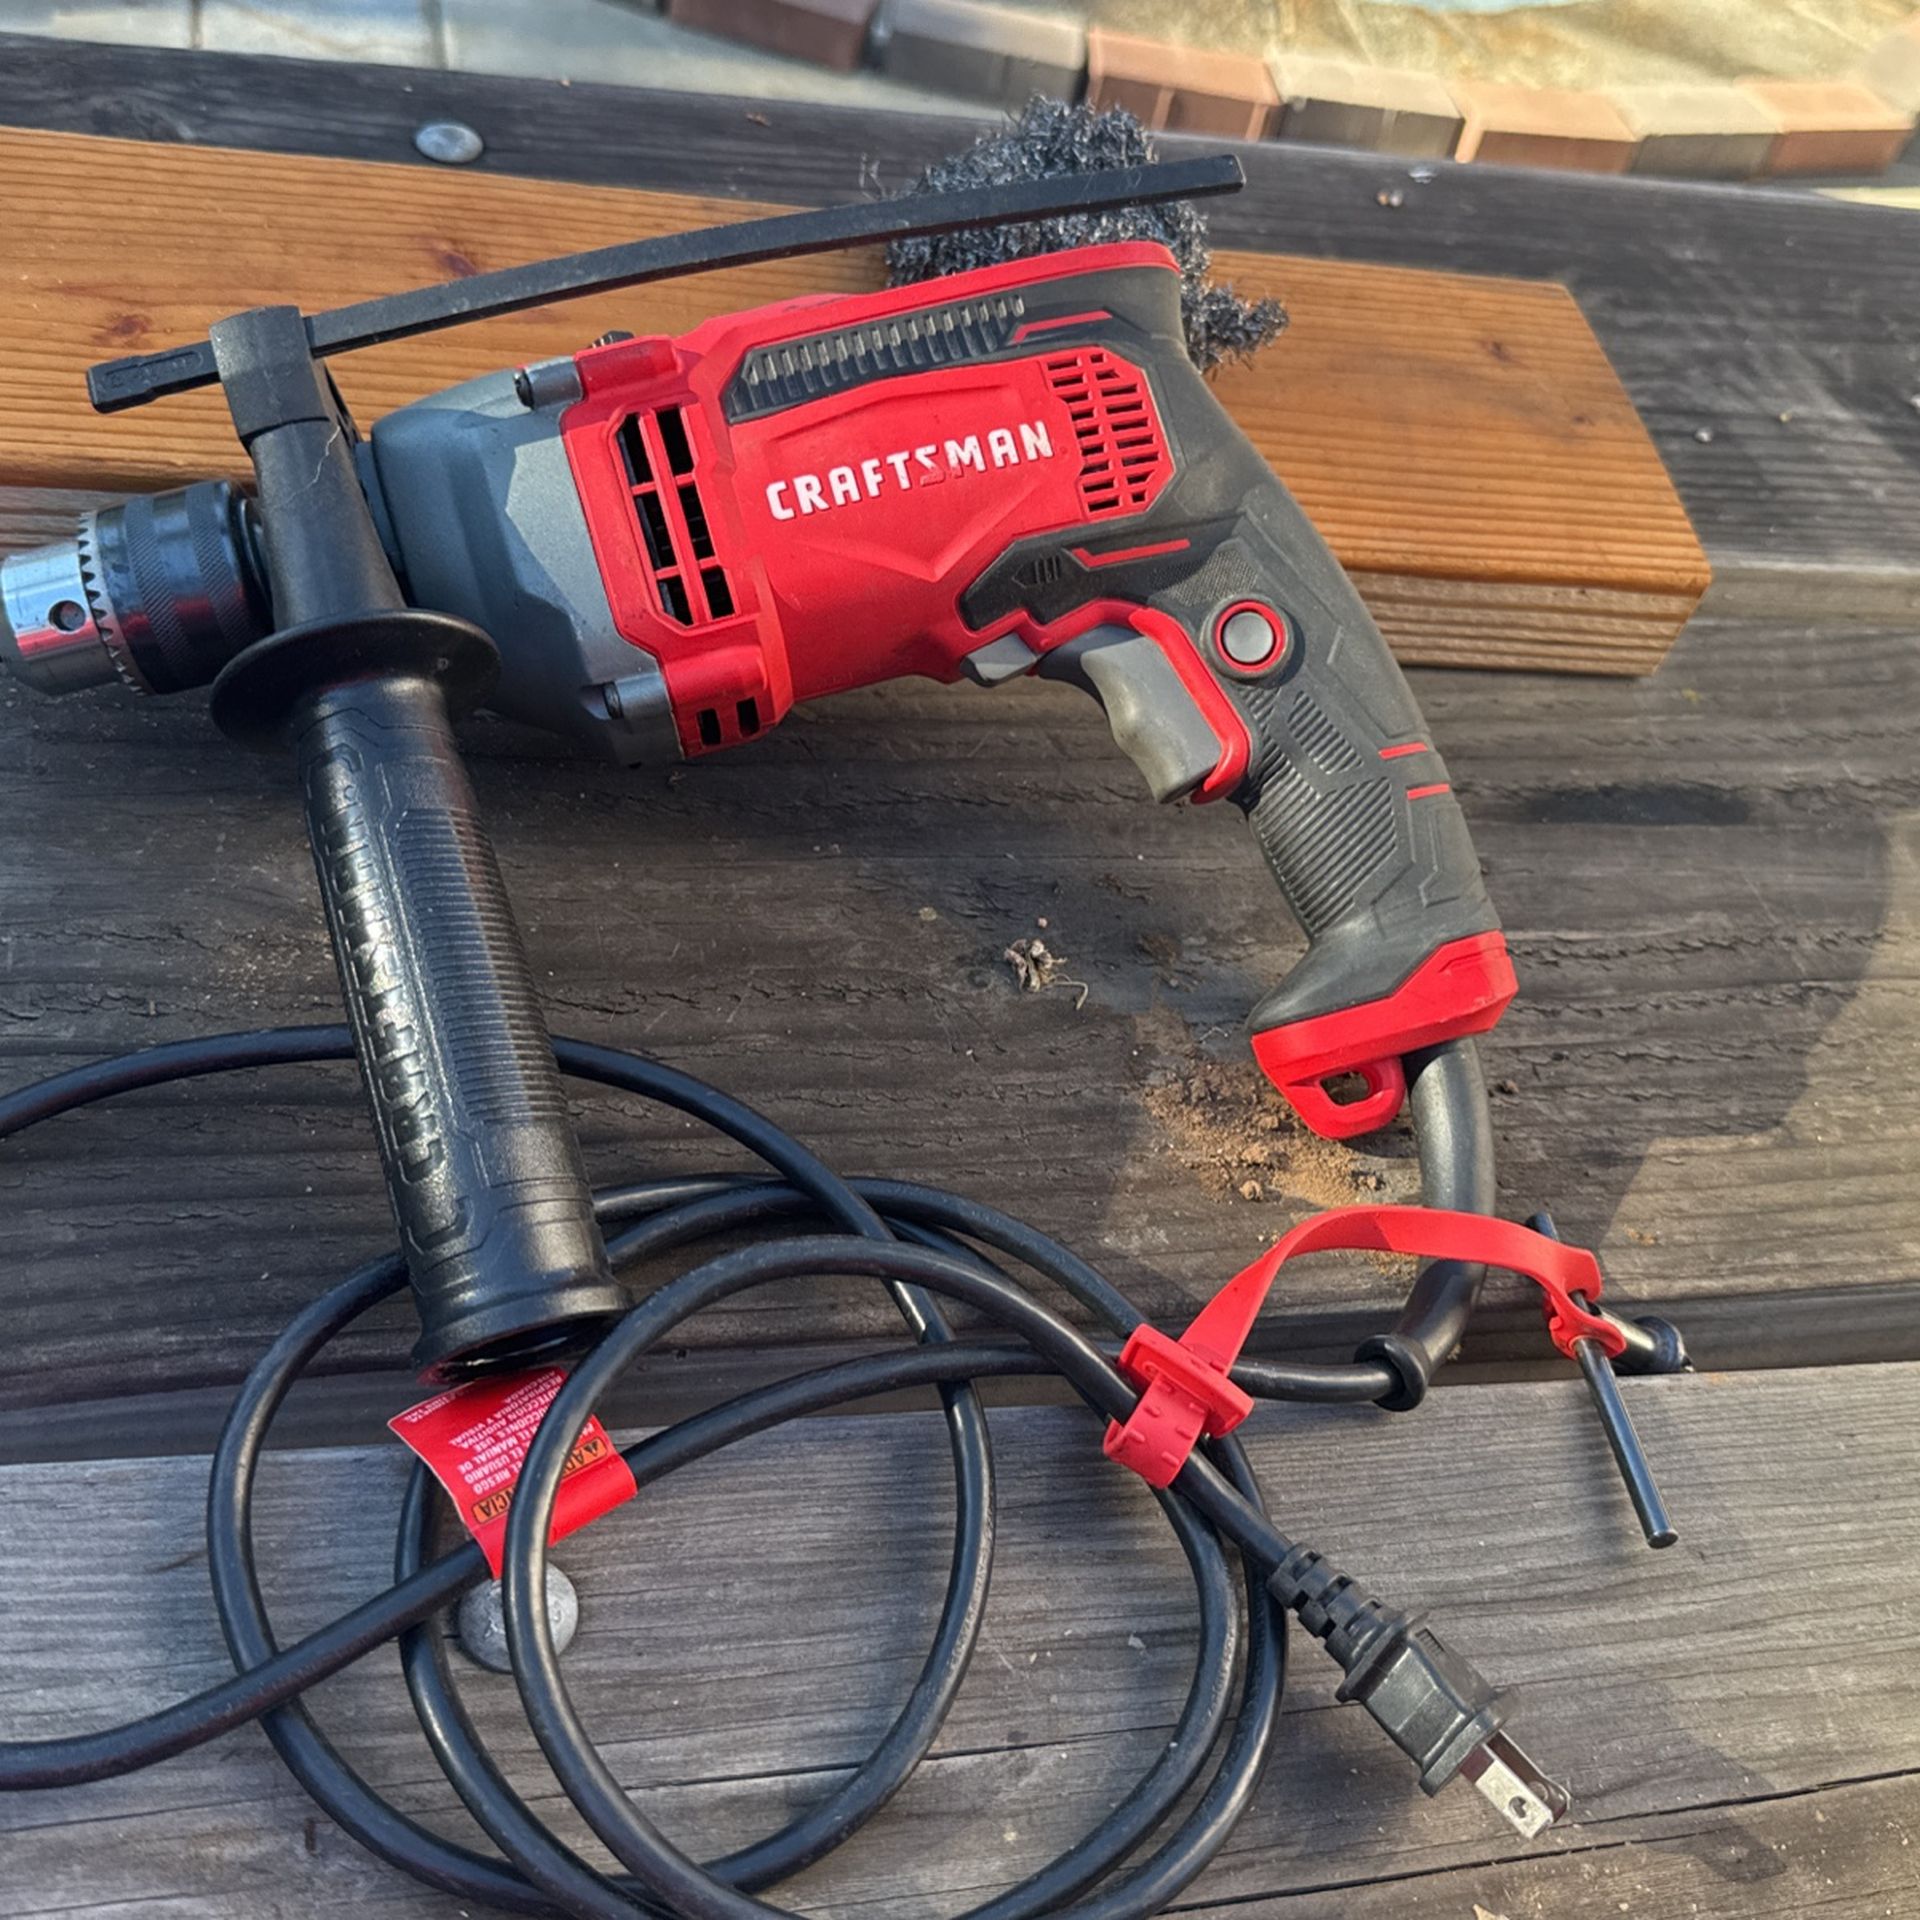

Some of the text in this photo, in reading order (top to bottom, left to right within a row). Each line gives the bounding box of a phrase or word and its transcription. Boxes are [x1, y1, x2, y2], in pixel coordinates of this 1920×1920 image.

[765, 420, 1054, 520] CRAFTSMAN
[448, 1375, 563, 1445] RESPIRATORIA Y VISUAL
[473, 1436, 495, 1453] USE
[473, 1435, 519, 1464] MANUAL
[457, 1460, 473, 1474] DE
[463, 1446, 524, 1485] EL USUARIO
[472, 1468, 511, 1496] RIESGO
